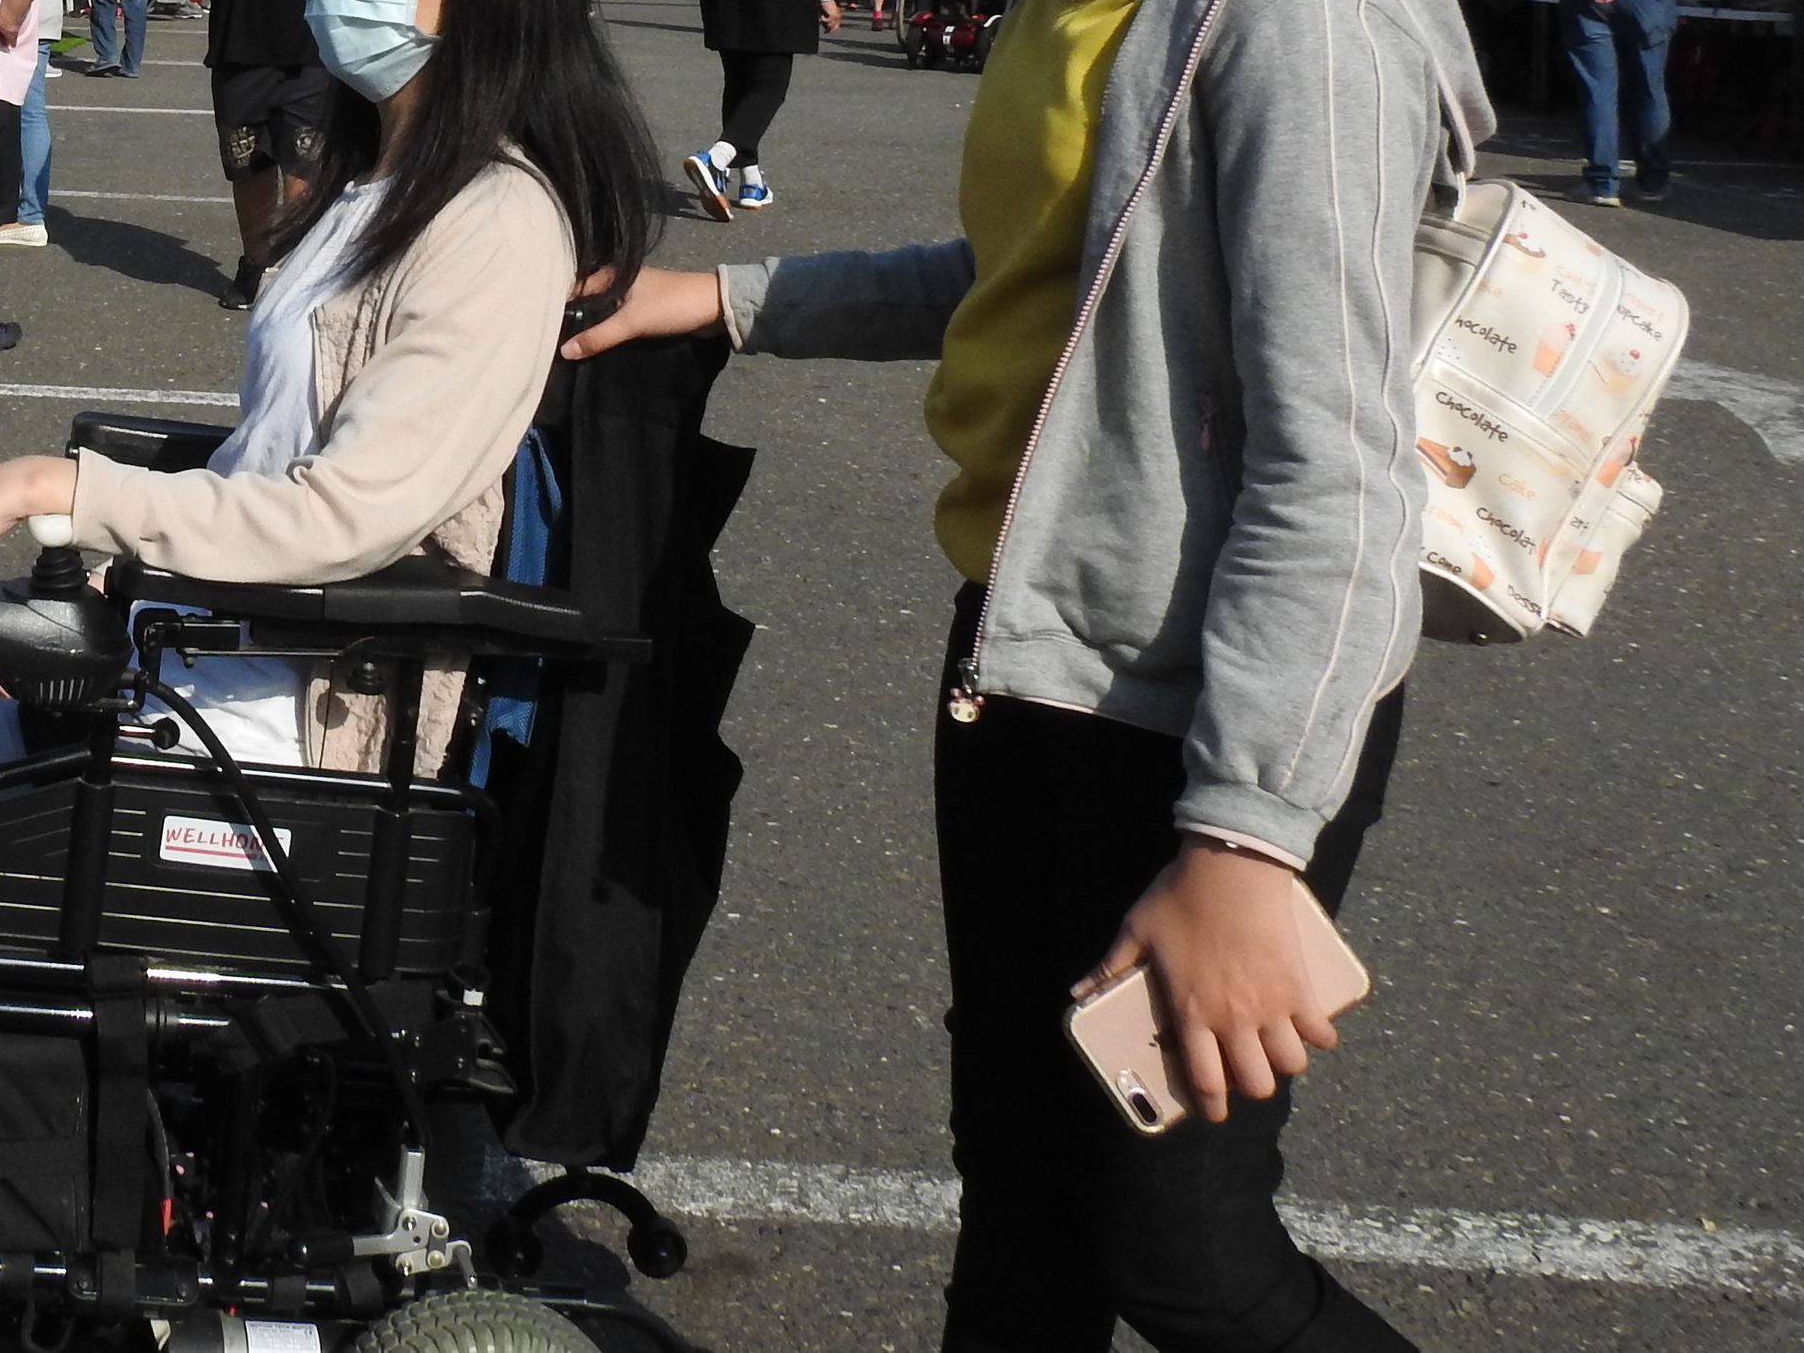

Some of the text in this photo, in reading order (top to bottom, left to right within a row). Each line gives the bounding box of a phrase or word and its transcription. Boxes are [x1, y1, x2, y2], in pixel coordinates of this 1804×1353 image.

[1551, 278, 1591, 315] Tasty
[1454, 314, 1518, 354] hocolate
[1435, 391, 1509, 443] Chocolate
[1476, 506, 1536, 556] Chocolat
[1507, 584, 1543, 617] Desse
